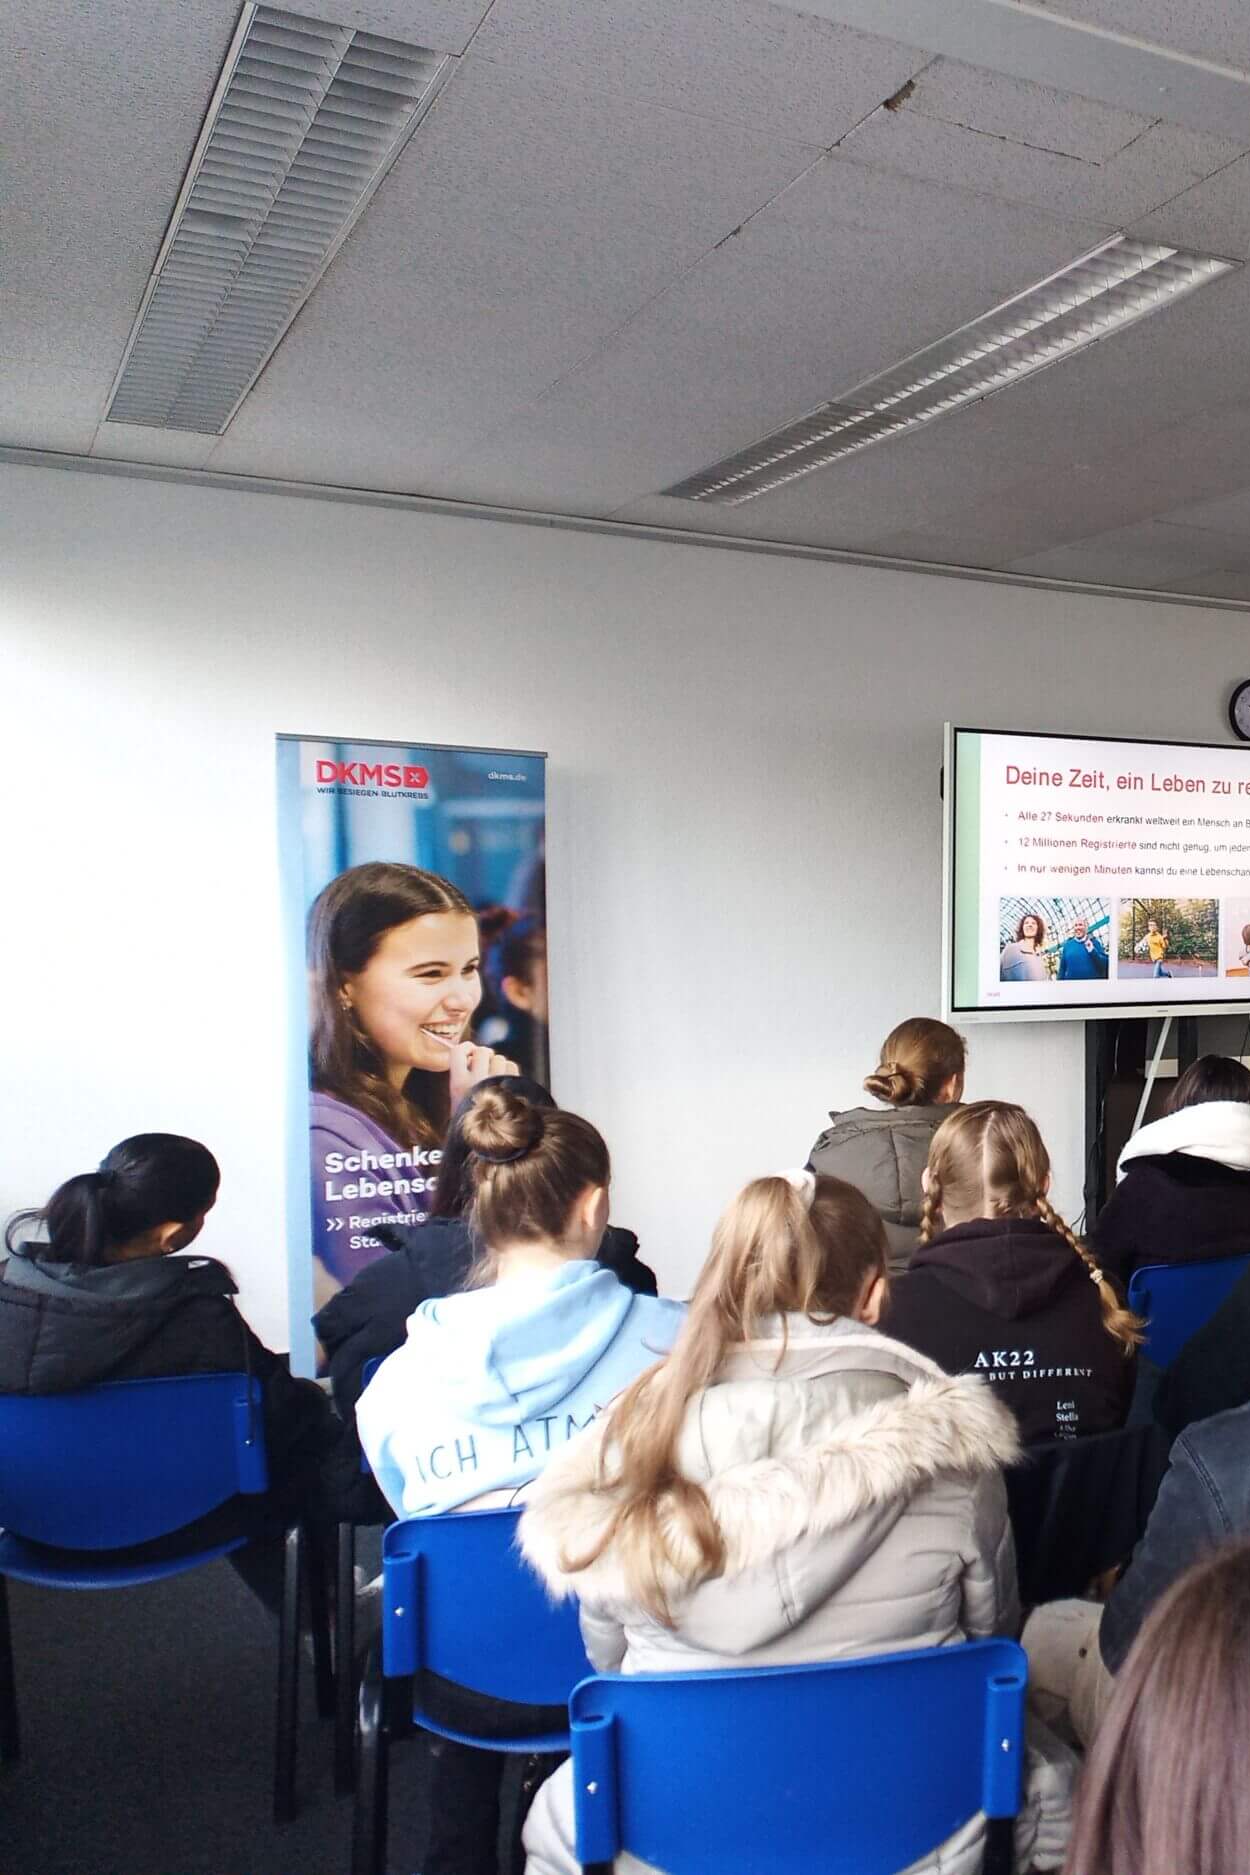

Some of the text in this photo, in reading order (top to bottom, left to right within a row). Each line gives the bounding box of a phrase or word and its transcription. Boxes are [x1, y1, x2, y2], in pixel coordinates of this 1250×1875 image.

[316, 760, 402, 788] DKMS
[487, 771, 527, 781] dkms.de
[1006, 765, 1063, 787] Deine
[1068, 768, 1110, 791] Zeit,
[1116, 771, 1144, 790] ein
[1151, 773, 1205, 793] Leben
[1212, 780, 1231, 794] zu
[381, 790, 429, 799] BLUTKREBS
[1018, 811, 1038, 821] Alle
[1040, 811, 1052, 821] 27
[1055, 812, 1104, 823] Sekunden
[1106, 814, 1143, 825] erkrankt
[1145, 816, 1180, 826] weltweit
[1182, 818, 1195, 826] ein
[1197, 817, 1231, 828] Mensch
[1019, 837, 1030, 847] 12
[1032, 838, 1077, 848] Millionen
[1080, 839, 1137, 851] Registrierte
[1139, 841, 1157, 850] sind
[1159, 841, 1180, 851] nicht
[1017, 864, 1027, 873] In
[1029, 865, 1046, 873] nur
[1049, 865, 1091, 876] wenigen
[1094, 865, 1132, 875] Minuten
[1134, 866, 1164, 876] kannst
[1166, 866, 1178, 876] du
[1179, 867, 1198, 876] eine
[325, 1146, 442, 1174] Schenke
[349, 1209, 427, 1229] Registrie
[974, 1350, 1035, 1368] AK22
[988, 1371, 1016, 1381] BUT
[1055, 1411, 1079, 1421] Stella
[416, 1435, 477, 1484] ICH
